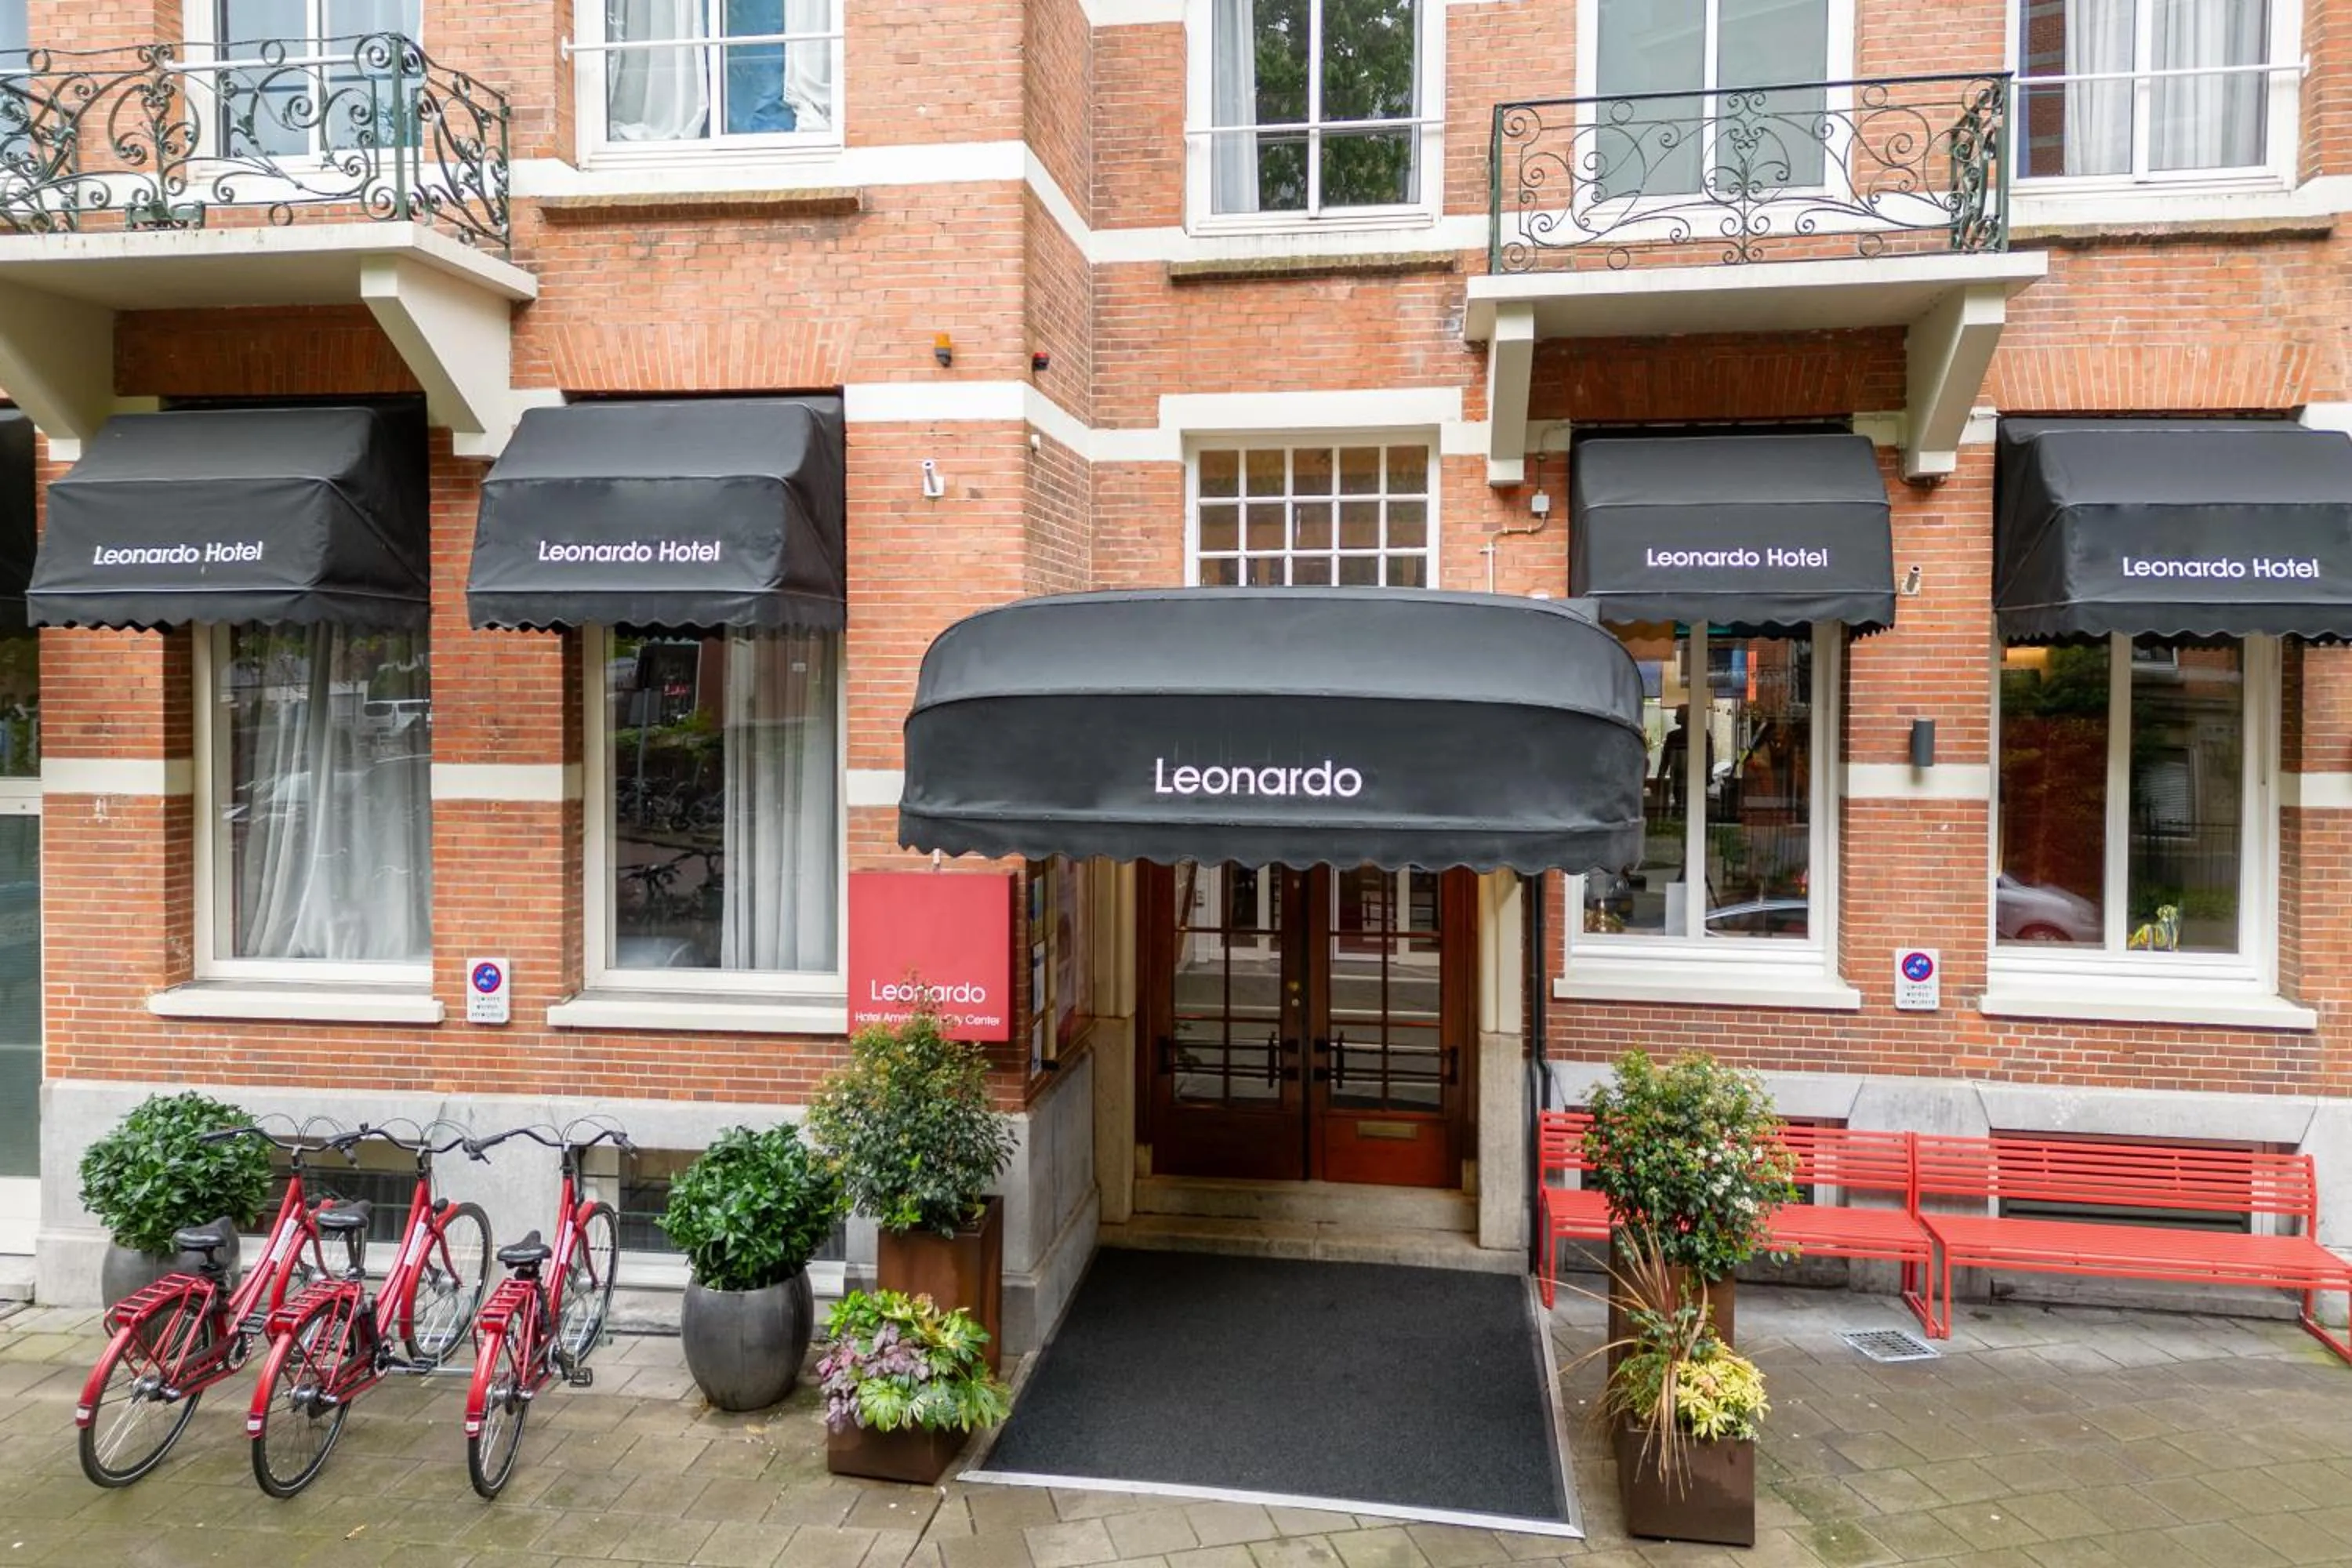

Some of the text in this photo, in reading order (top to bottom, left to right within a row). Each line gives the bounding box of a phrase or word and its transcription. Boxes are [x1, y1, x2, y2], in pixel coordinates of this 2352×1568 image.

[93, 540, 263, 565] Leonardo Hotel
[539, 540, 720, 561] Leonardo Hotel
[1646, 548, 1828, 567] Leonardo Hotel
[2122, 557, 2321, 578] Leonardo Hotel
[1155, 757, 1363, 797] Leonardo
[871, 979, 986, 1004] Leonardo
[965, 1014, 1001, 1026] Center
